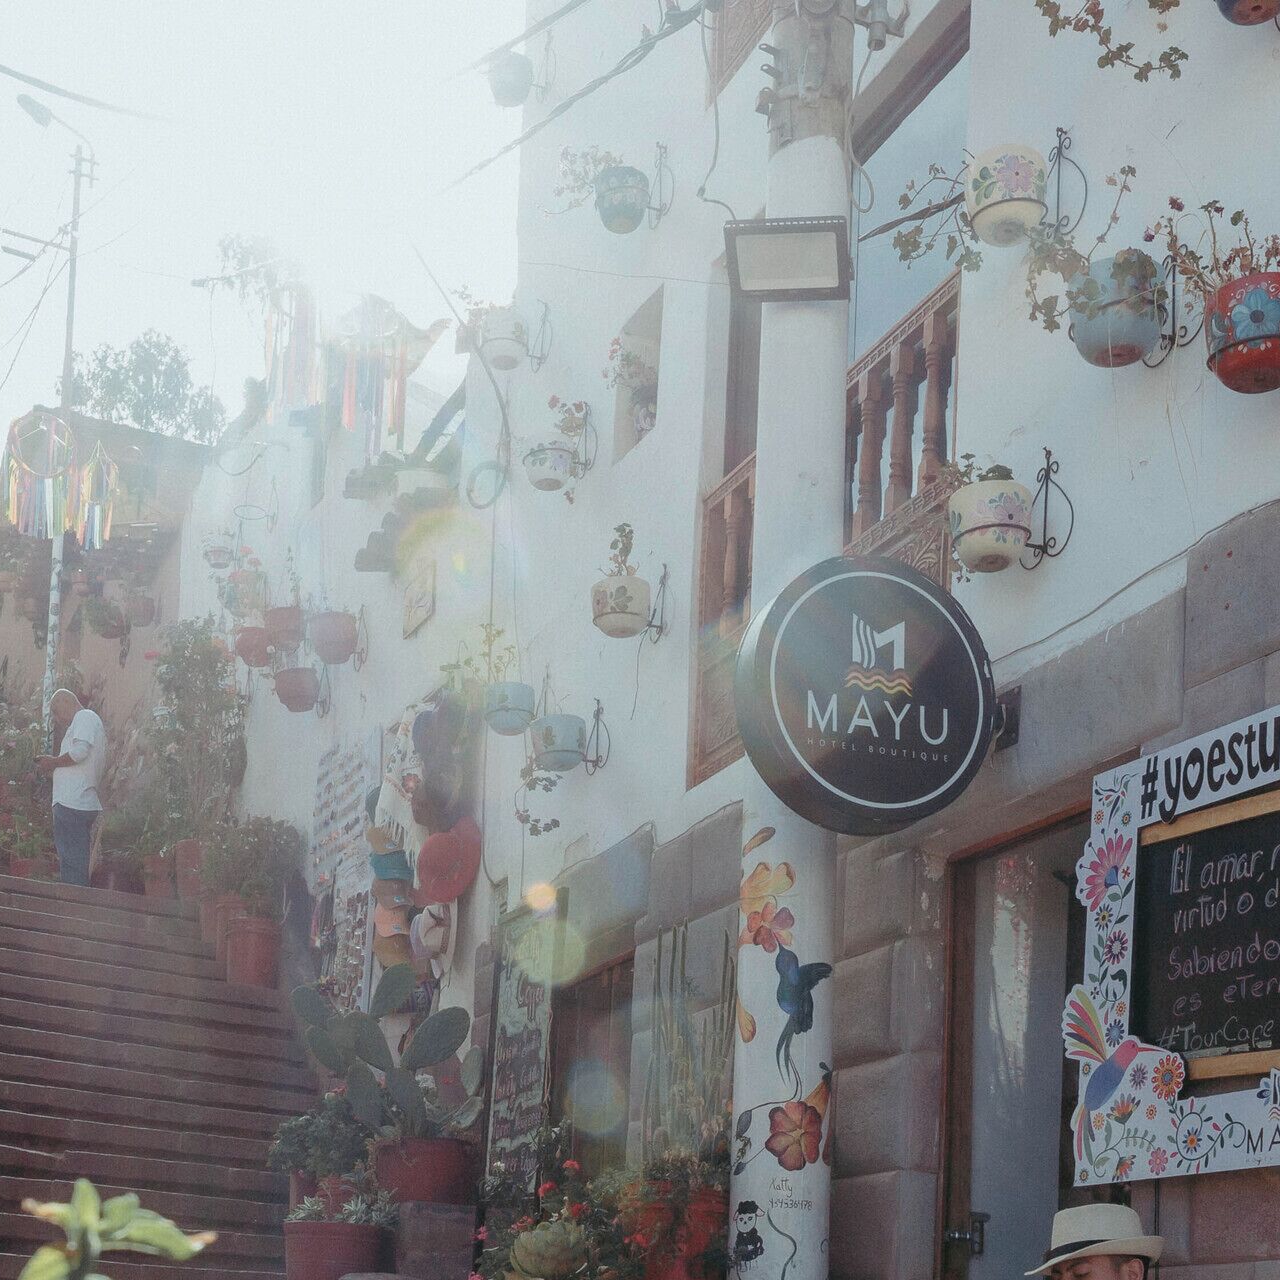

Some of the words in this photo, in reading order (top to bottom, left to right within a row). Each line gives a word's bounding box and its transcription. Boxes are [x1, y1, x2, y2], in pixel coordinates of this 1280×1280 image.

[807, 689, 949, 746] MAYU
[807, 737, 856, 751] HOTEL
[868, 745, 949, 763] BOUTIQUE
[1236, 892, 1255, 915] o
[1173, 992, 1202, 1016] es
